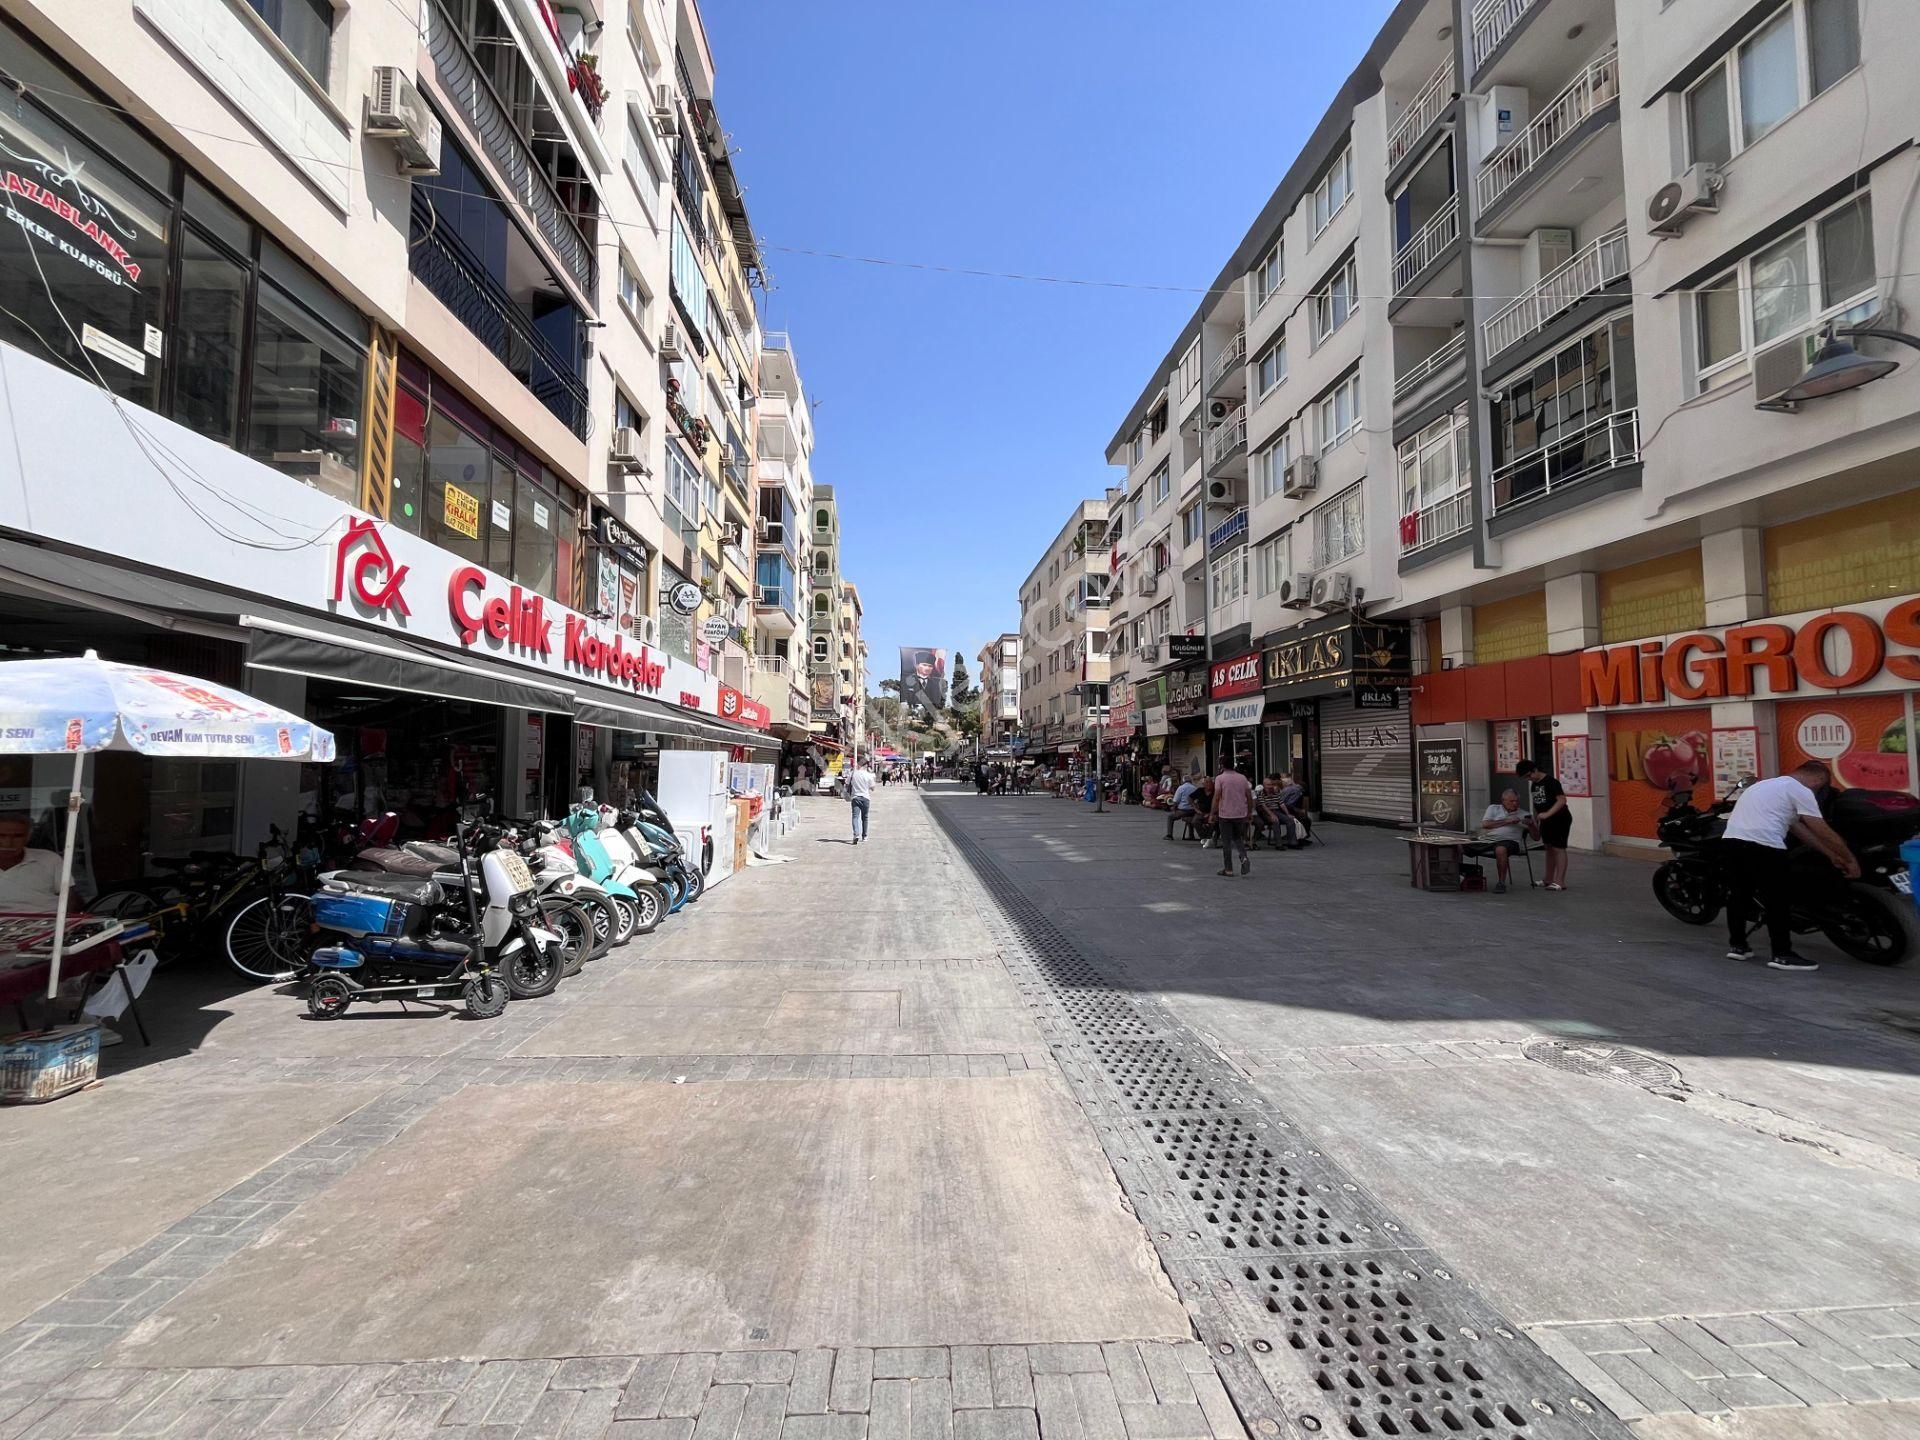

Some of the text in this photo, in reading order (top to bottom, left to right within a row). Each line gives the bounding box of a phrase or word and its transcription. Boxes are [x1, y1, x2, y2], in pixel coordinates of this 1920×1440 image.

[0, 169, 142, 282] AZABLANKA
[6, 210, 122, 286] ERKEK KUAFÖRÜ
[448, 567, 552, 646] Çelik
[564, 614, 665, 692] Kardeşler
[1212, 670, 1225, 688] AS
[1228, 657, 1258, 687] ÇELİK
[150, 728, 183, 743] DEVAM
[205, 734, 233, 744] TUTAR
[1223, 703, 1258, 720] DAIKIN
